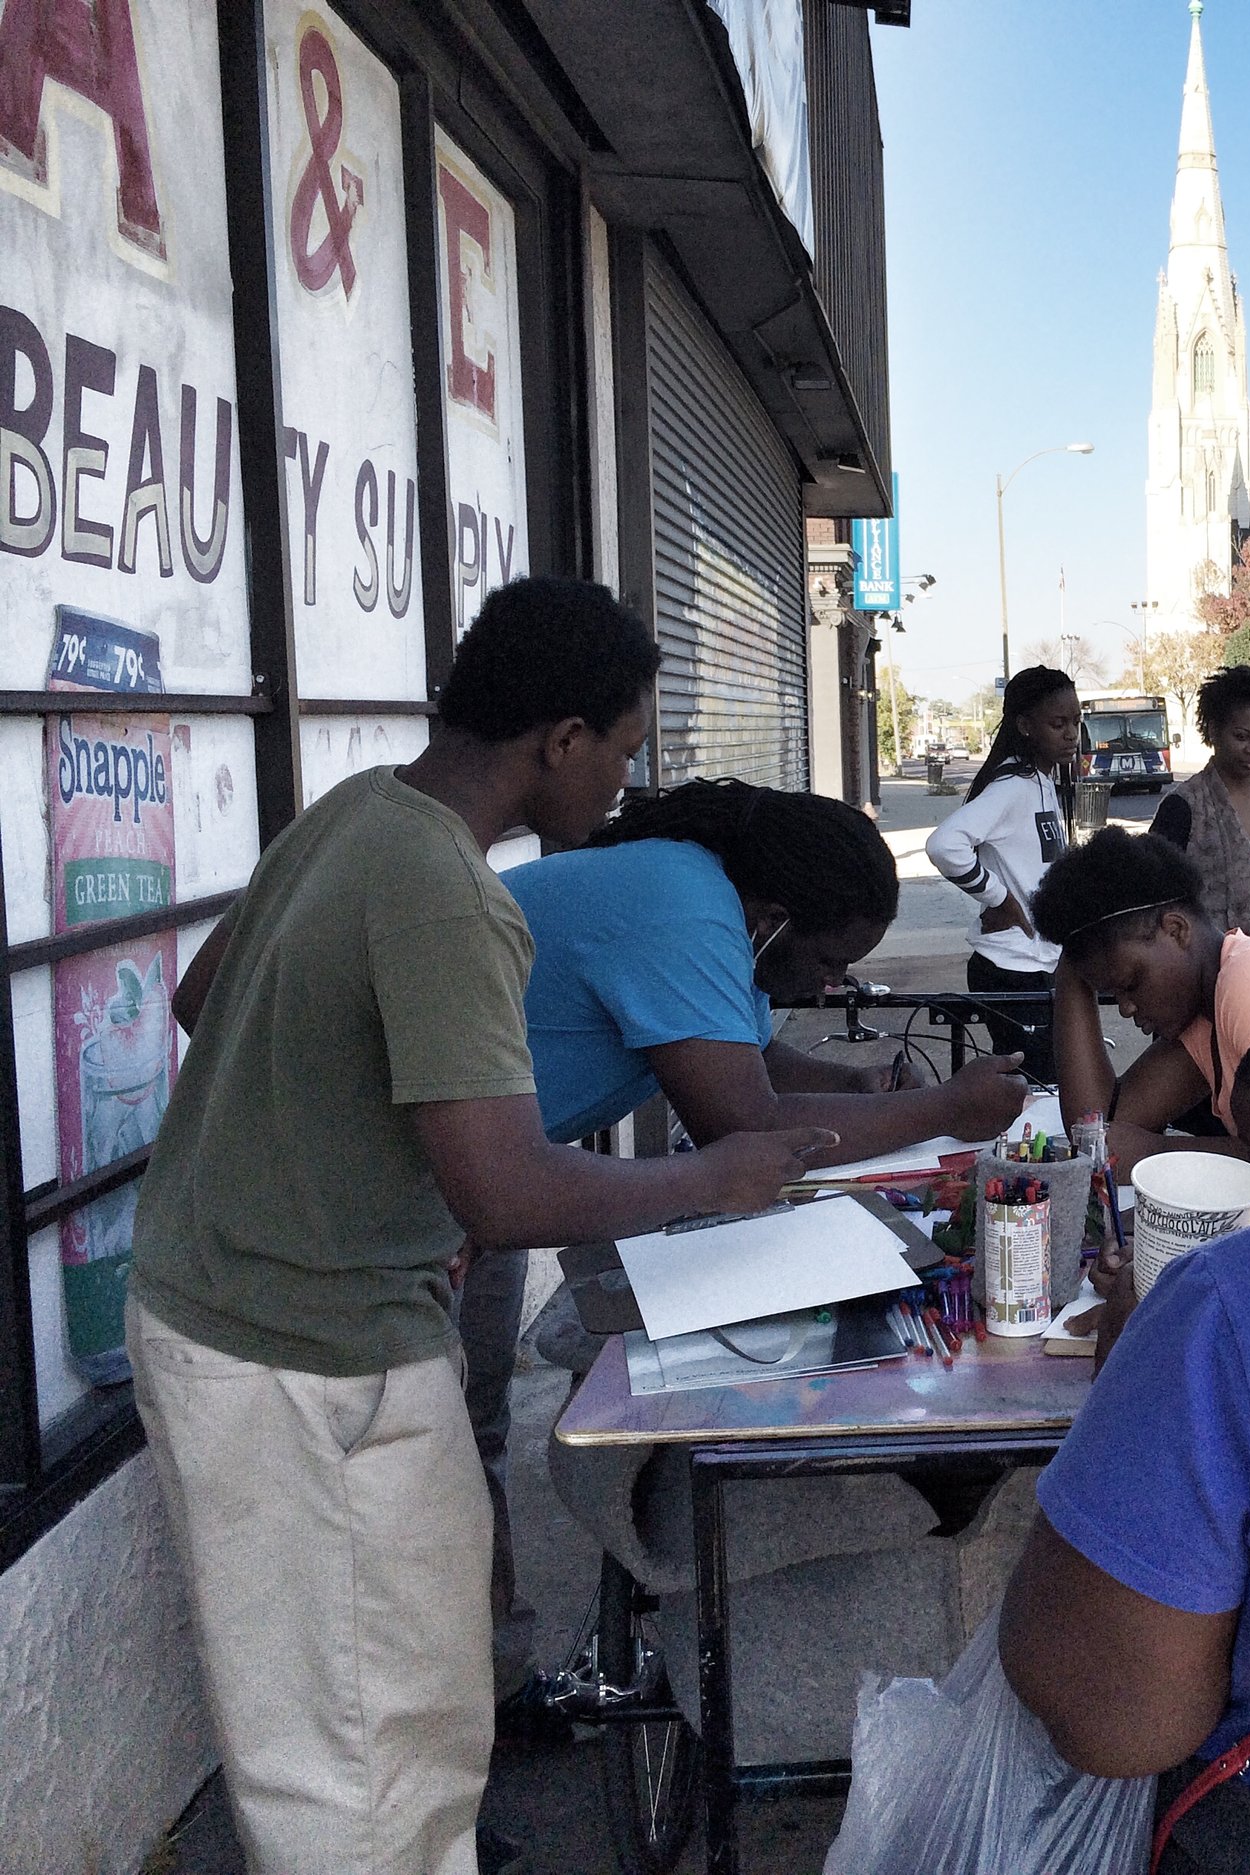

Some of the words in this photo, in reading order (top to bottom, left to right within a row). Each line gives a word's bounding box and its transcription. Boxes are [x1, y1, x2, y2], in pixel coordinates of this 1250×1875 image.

[291, 26, 364, 303] &
[438, 166, 497, 424] E
[859, 580, 895, 592] BANK
[59, 713, 166, 824] Snapple
[95, 829, 146, 855] PEACH
[75, 873, 131, 906] GREEN
[136, 874, 163, 905] TEA
